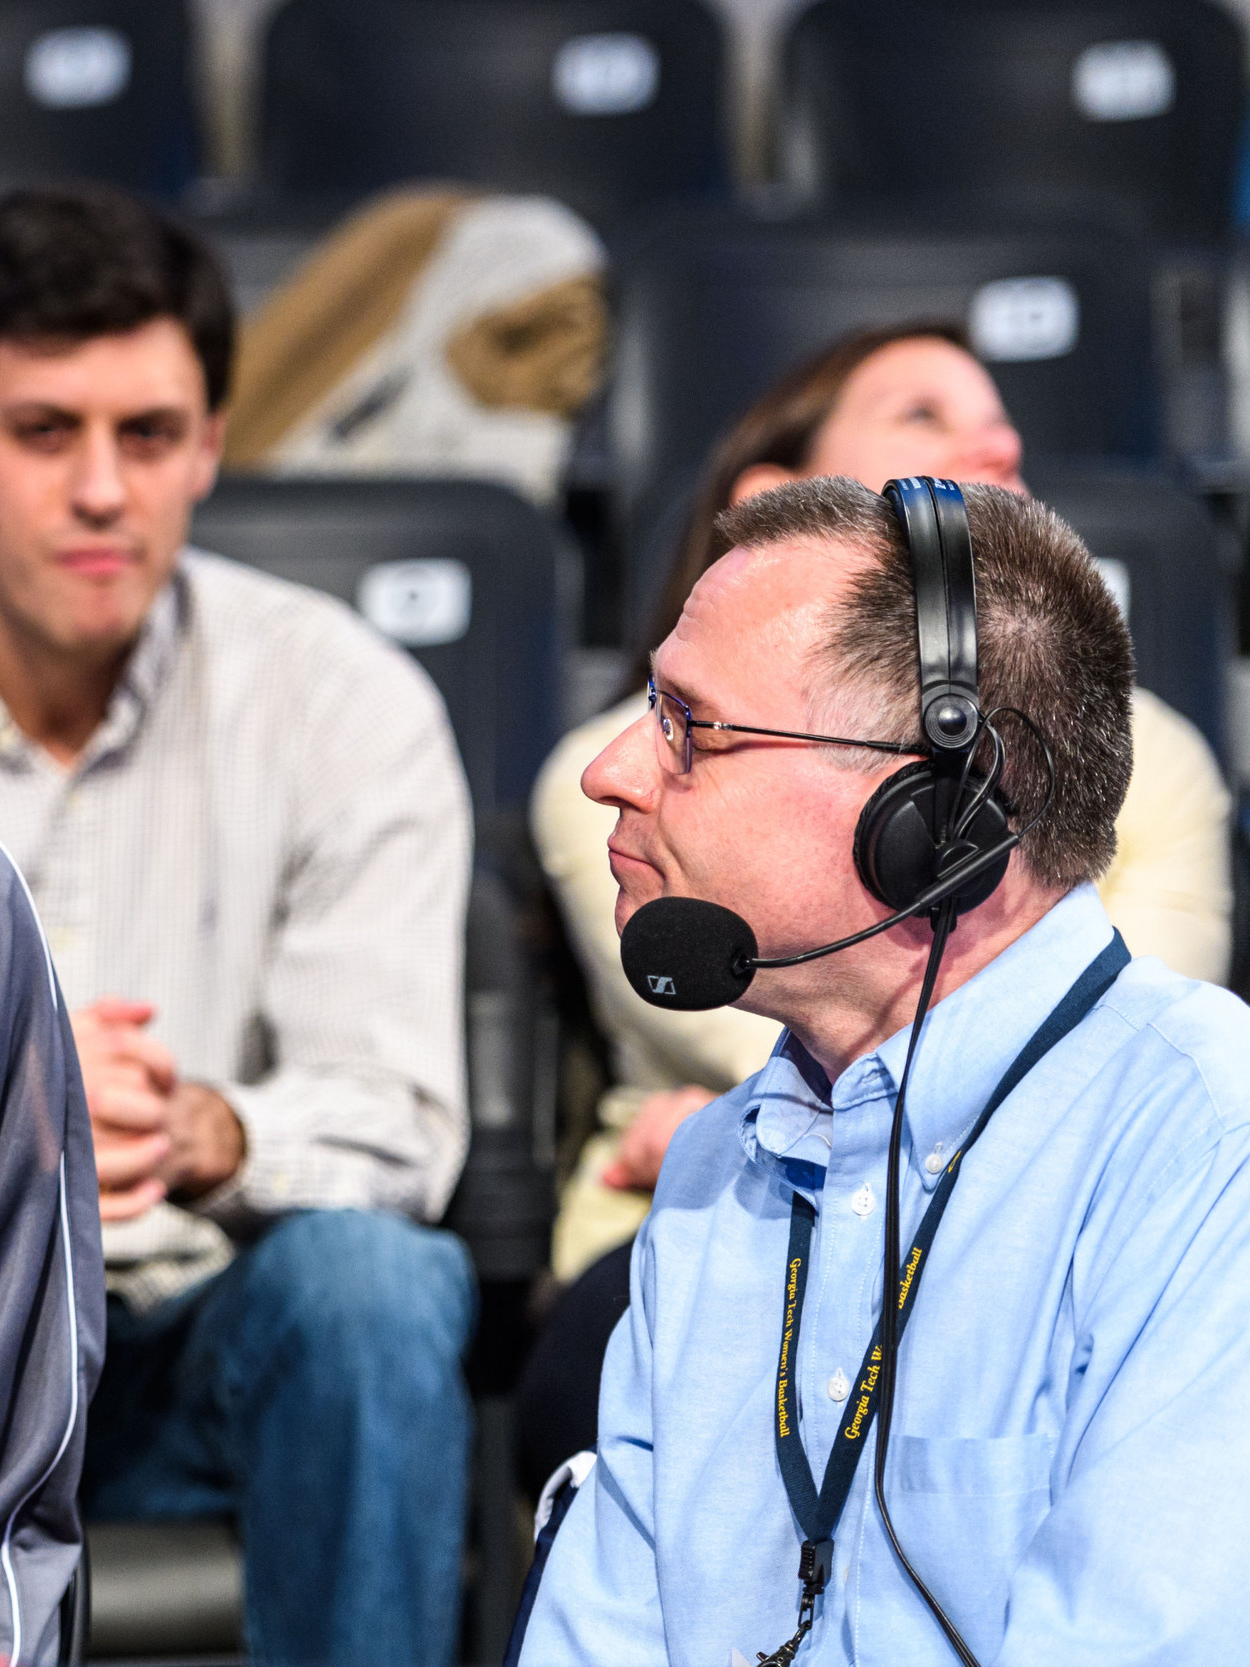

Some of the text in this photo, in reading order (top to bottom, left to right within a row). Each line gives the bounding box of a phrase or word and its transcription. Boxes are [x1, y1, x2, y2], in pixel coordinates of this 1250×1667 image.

[778, 1257, 802, 1438] Georgia Tech Women's Basketball
[844, 1395, 870, 1440] Georgia
[859, 1365, 881, 1392] Tech
